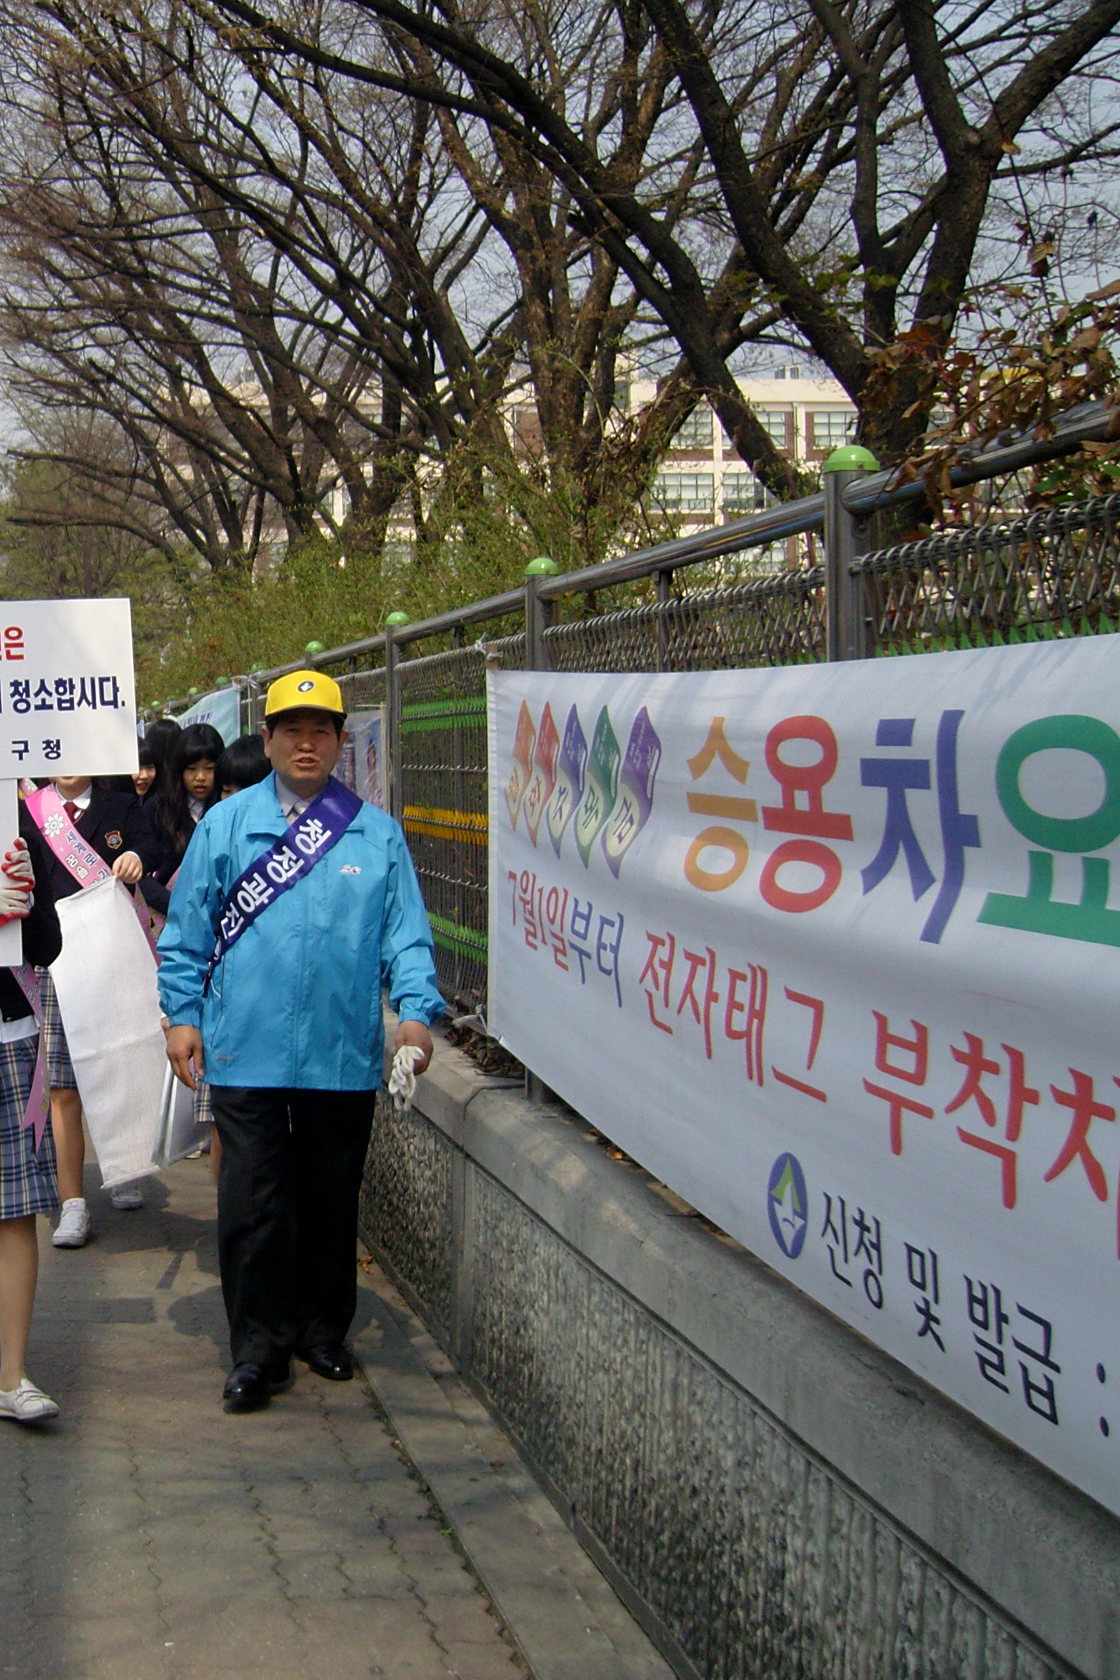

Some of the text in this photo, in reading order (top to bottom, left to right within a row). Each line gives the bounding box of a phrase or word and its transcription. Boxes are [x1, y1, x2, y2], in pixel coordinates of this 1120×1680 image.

[9, 675, 126, 714] 청소합시다.
[637, 930, 828, 1105] 전자태그
[821, 1191, 885, 1310] 신청
[903, 1241, 946, 1354] 및
[963, 1273, 1061, 1426] 발급
